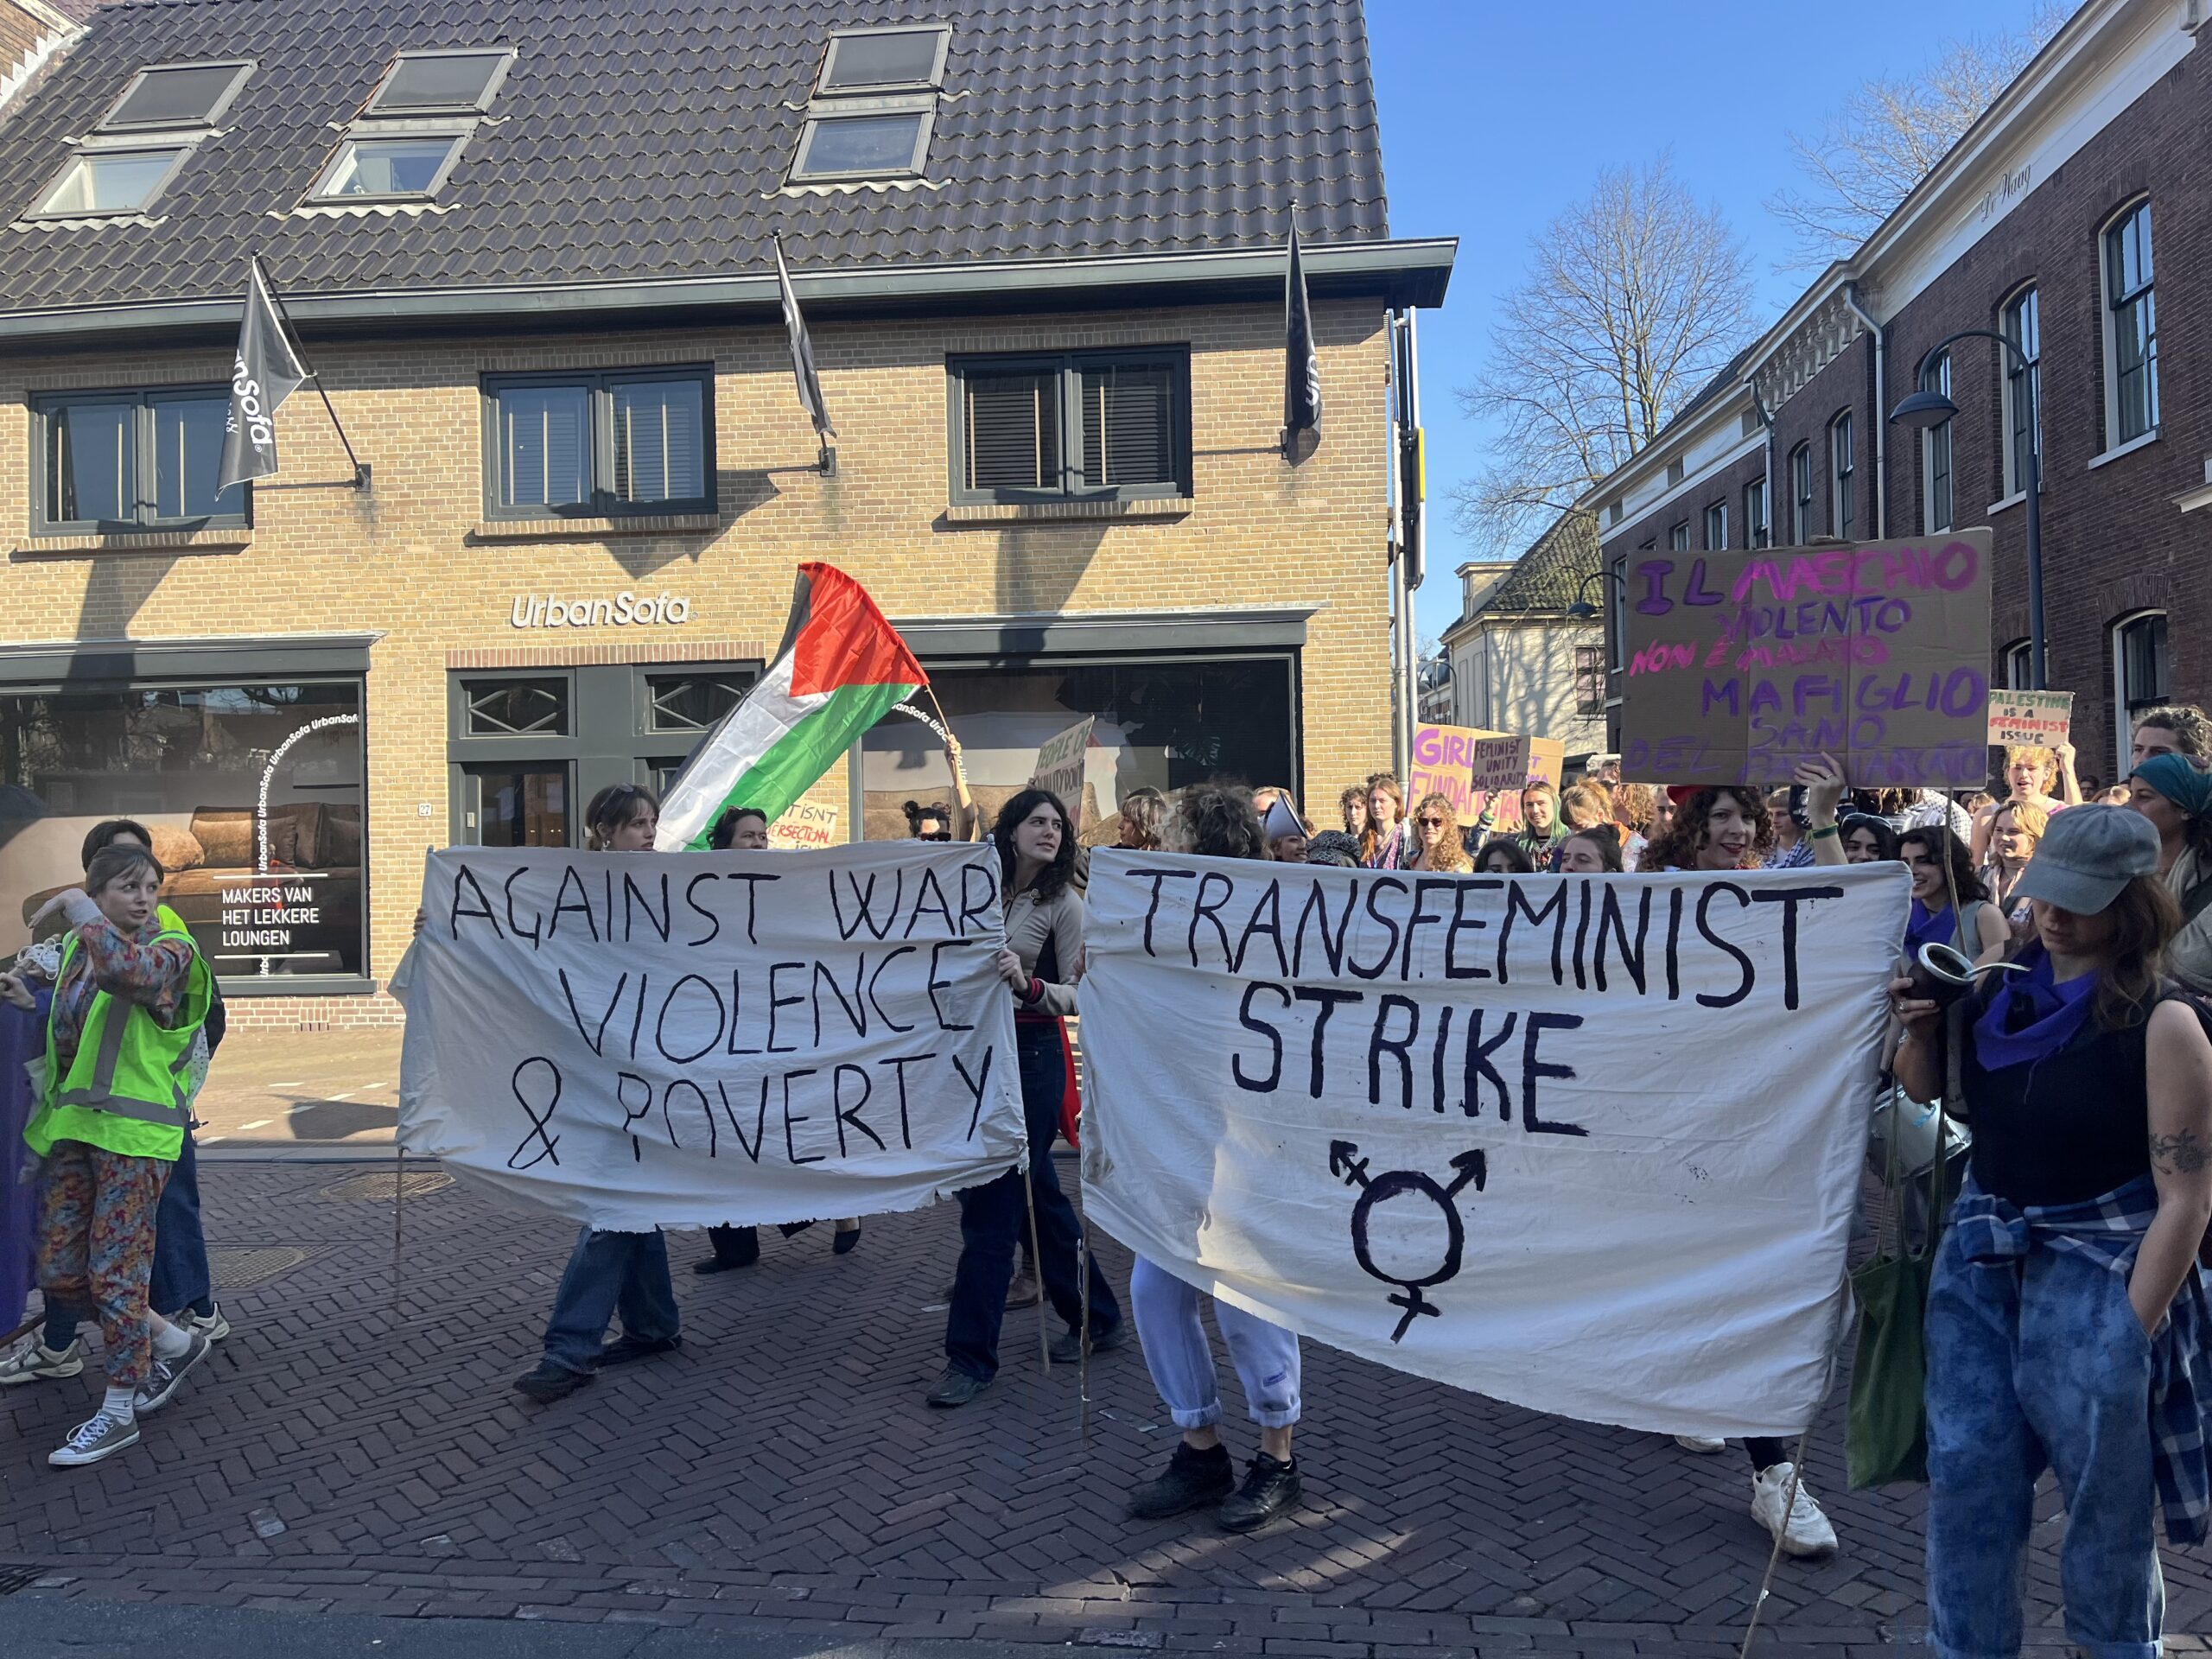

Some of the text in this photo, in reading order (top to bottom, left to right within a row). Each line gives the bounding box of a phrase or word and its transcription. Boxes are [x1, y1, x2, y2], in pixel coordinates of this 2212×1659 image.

[1636, 541, 1979, 616] IL MASCHIO
[512, 591, 690, 628] UrbanSofa
[1714, 596, 1912, 643] VIOLENTO
[1630, 640, 1698, 677] NON
[1989, 691, 2069, 709] PALESTINE
[2004, 708, 2034, 718] IS A
[1751, 714, 1887, 750] SANO
[1990, 716, 2068, 733] FEMINIST
[270, 724, 310, 766] UrbanSofa
[1475, 738, 1522, 760] FEMINIST
[1624, 735, 1723, 772] DEL
[1472, 772, 1526, 789] SOLIDARITY
[1486, 756, 1518, 773] UNITY
[257, 765, 274, 817] UrbanSofa
[420, 804, 430, 815] 27
[257, 820, 268, 871] UrbanSofa
[222, 887, 312, 904] MAKERS VAN
[451, 864, 997, 950] AGAINST WAR
[223, 907, 320, 925] HET LEKKERE
[223, 929, 289, 946] LOUNGEN
[1126, 869, 1844, 1010] TRANSFEMINIST
[559, 939, 976, 1064] VIOLENCE
[1232, 982, 1589, 1136] STRIKE
[507, 1046, 994, 1170] & POVERTY
